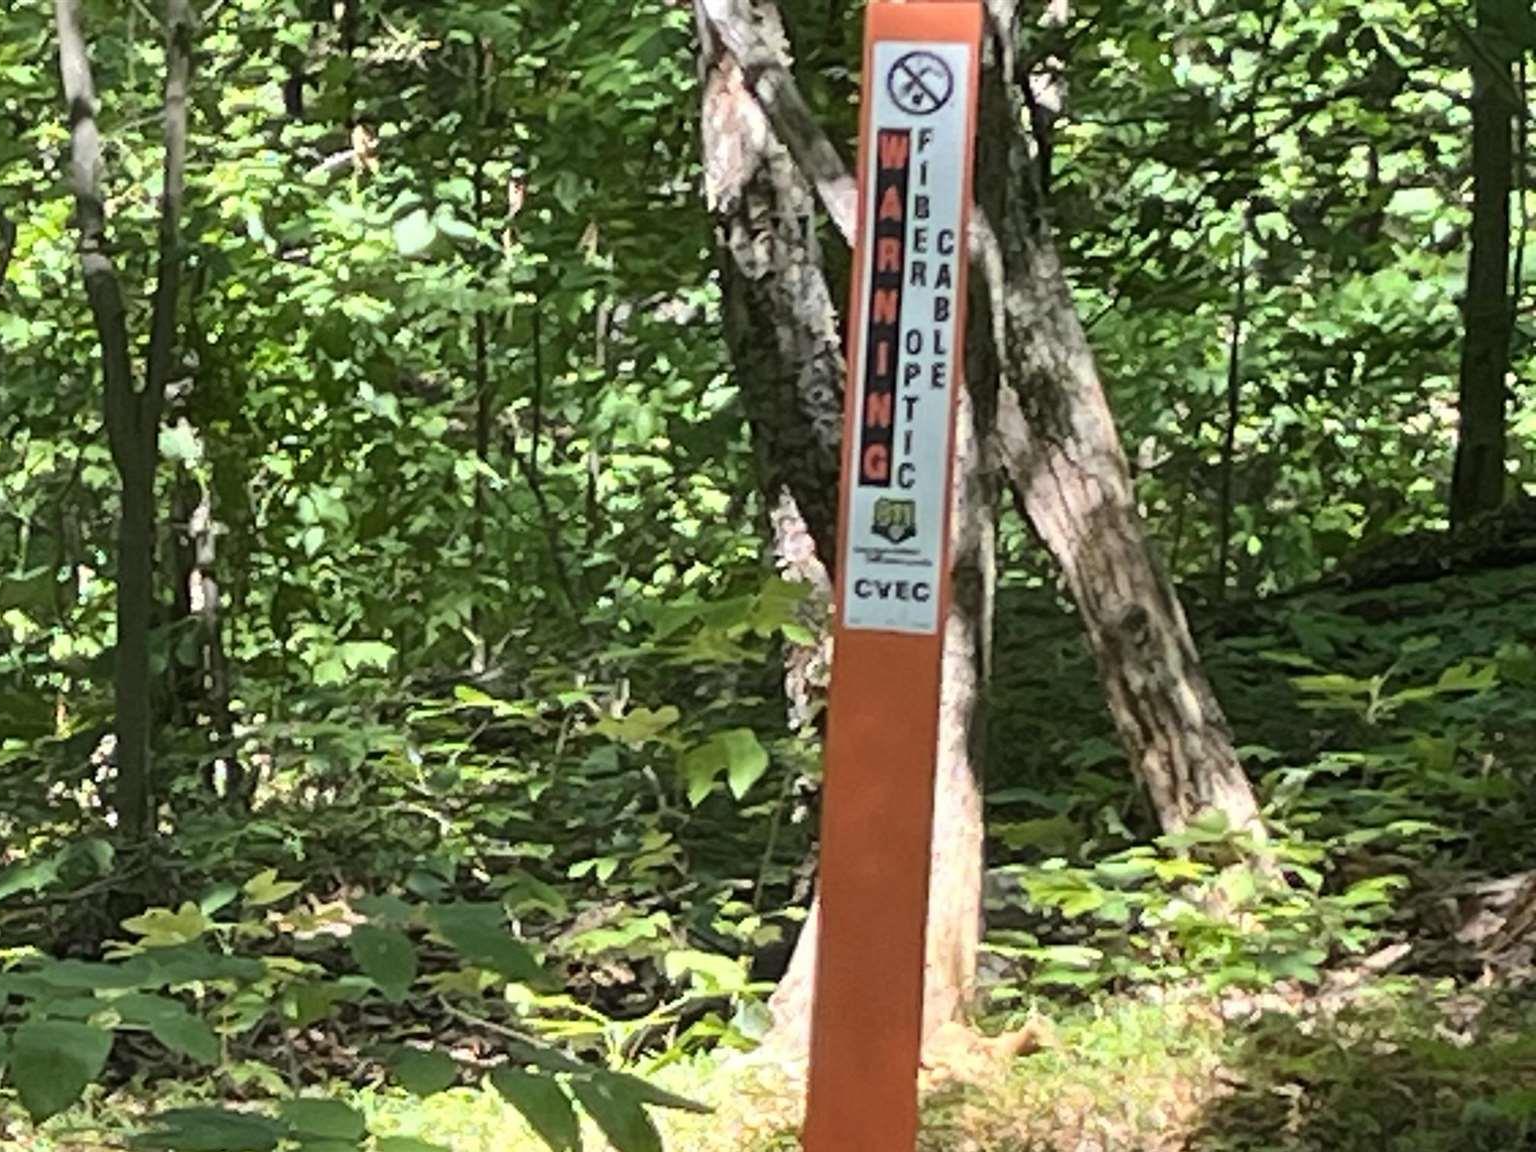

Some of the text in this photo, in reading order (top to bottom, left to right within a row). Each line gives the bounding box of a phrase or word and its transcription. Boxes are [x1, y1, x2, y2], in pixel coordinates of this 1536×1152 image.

[864, 134, 908, 481] WARNING
[897, 128, 934, 489] FIBER OPTIC
[931, 229, 954, 389] CABLE
[855, 578, 930, 602] CVEC
